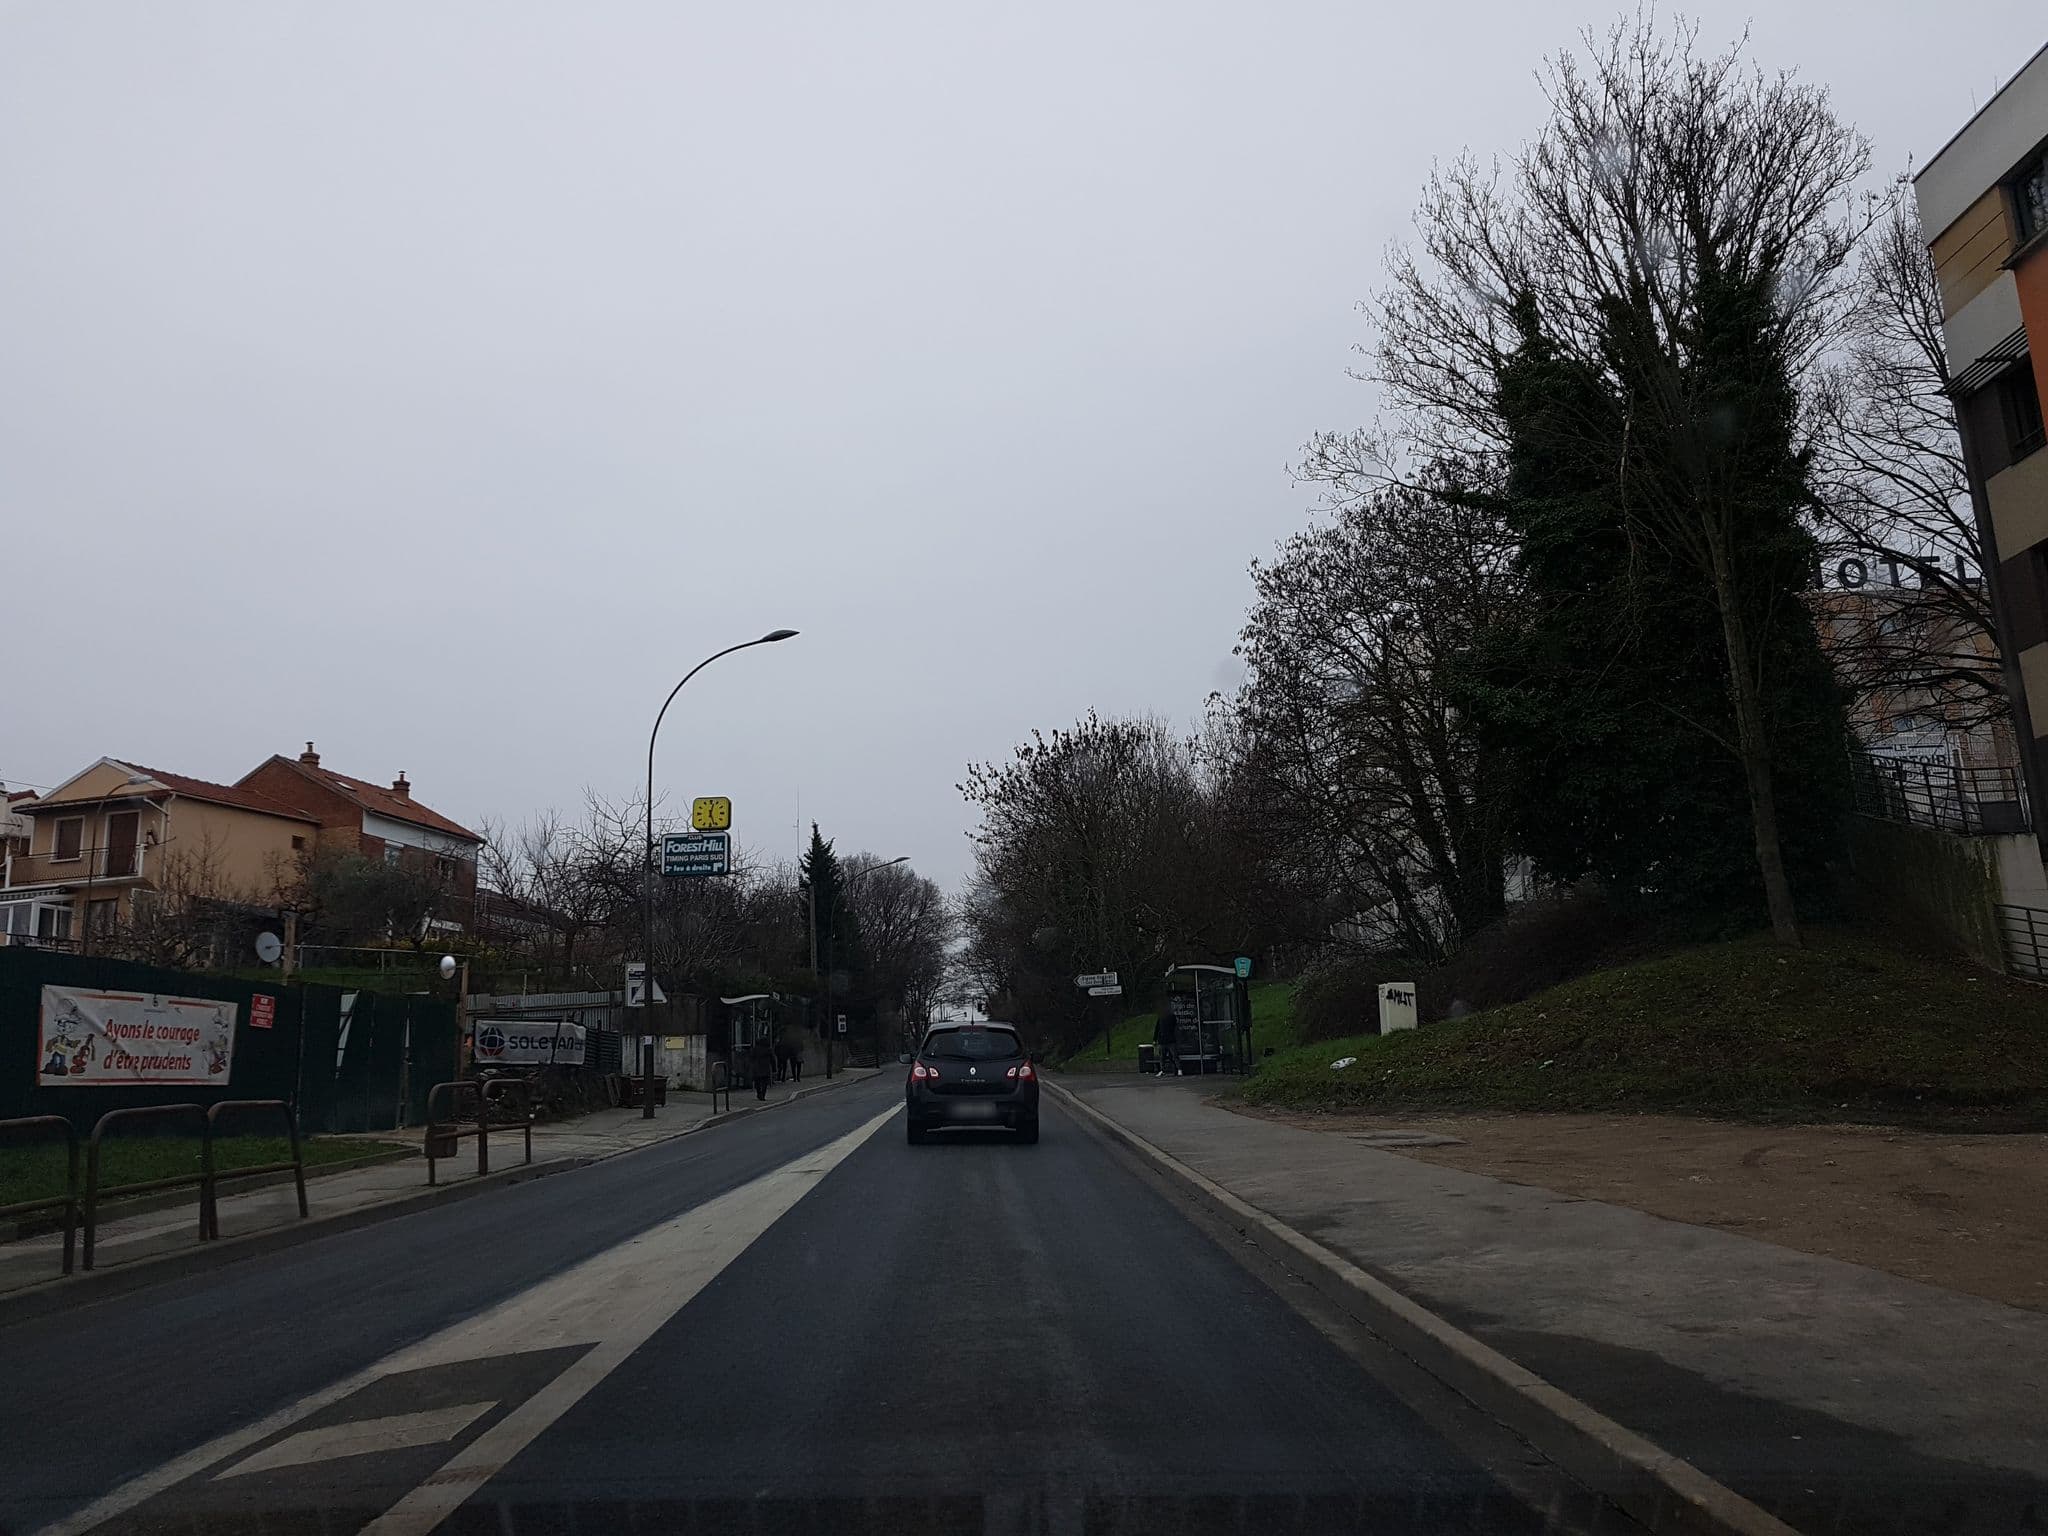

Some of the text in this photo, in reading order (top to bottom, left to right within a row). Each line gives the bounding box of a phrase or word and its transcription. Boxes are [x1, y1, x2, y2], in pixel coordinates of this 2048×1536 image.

[710, 853, 724, 861] SUD
[103, 1019, 200, 1045] Ayons le courage
[141, 1053, 192, 1073] prudents
